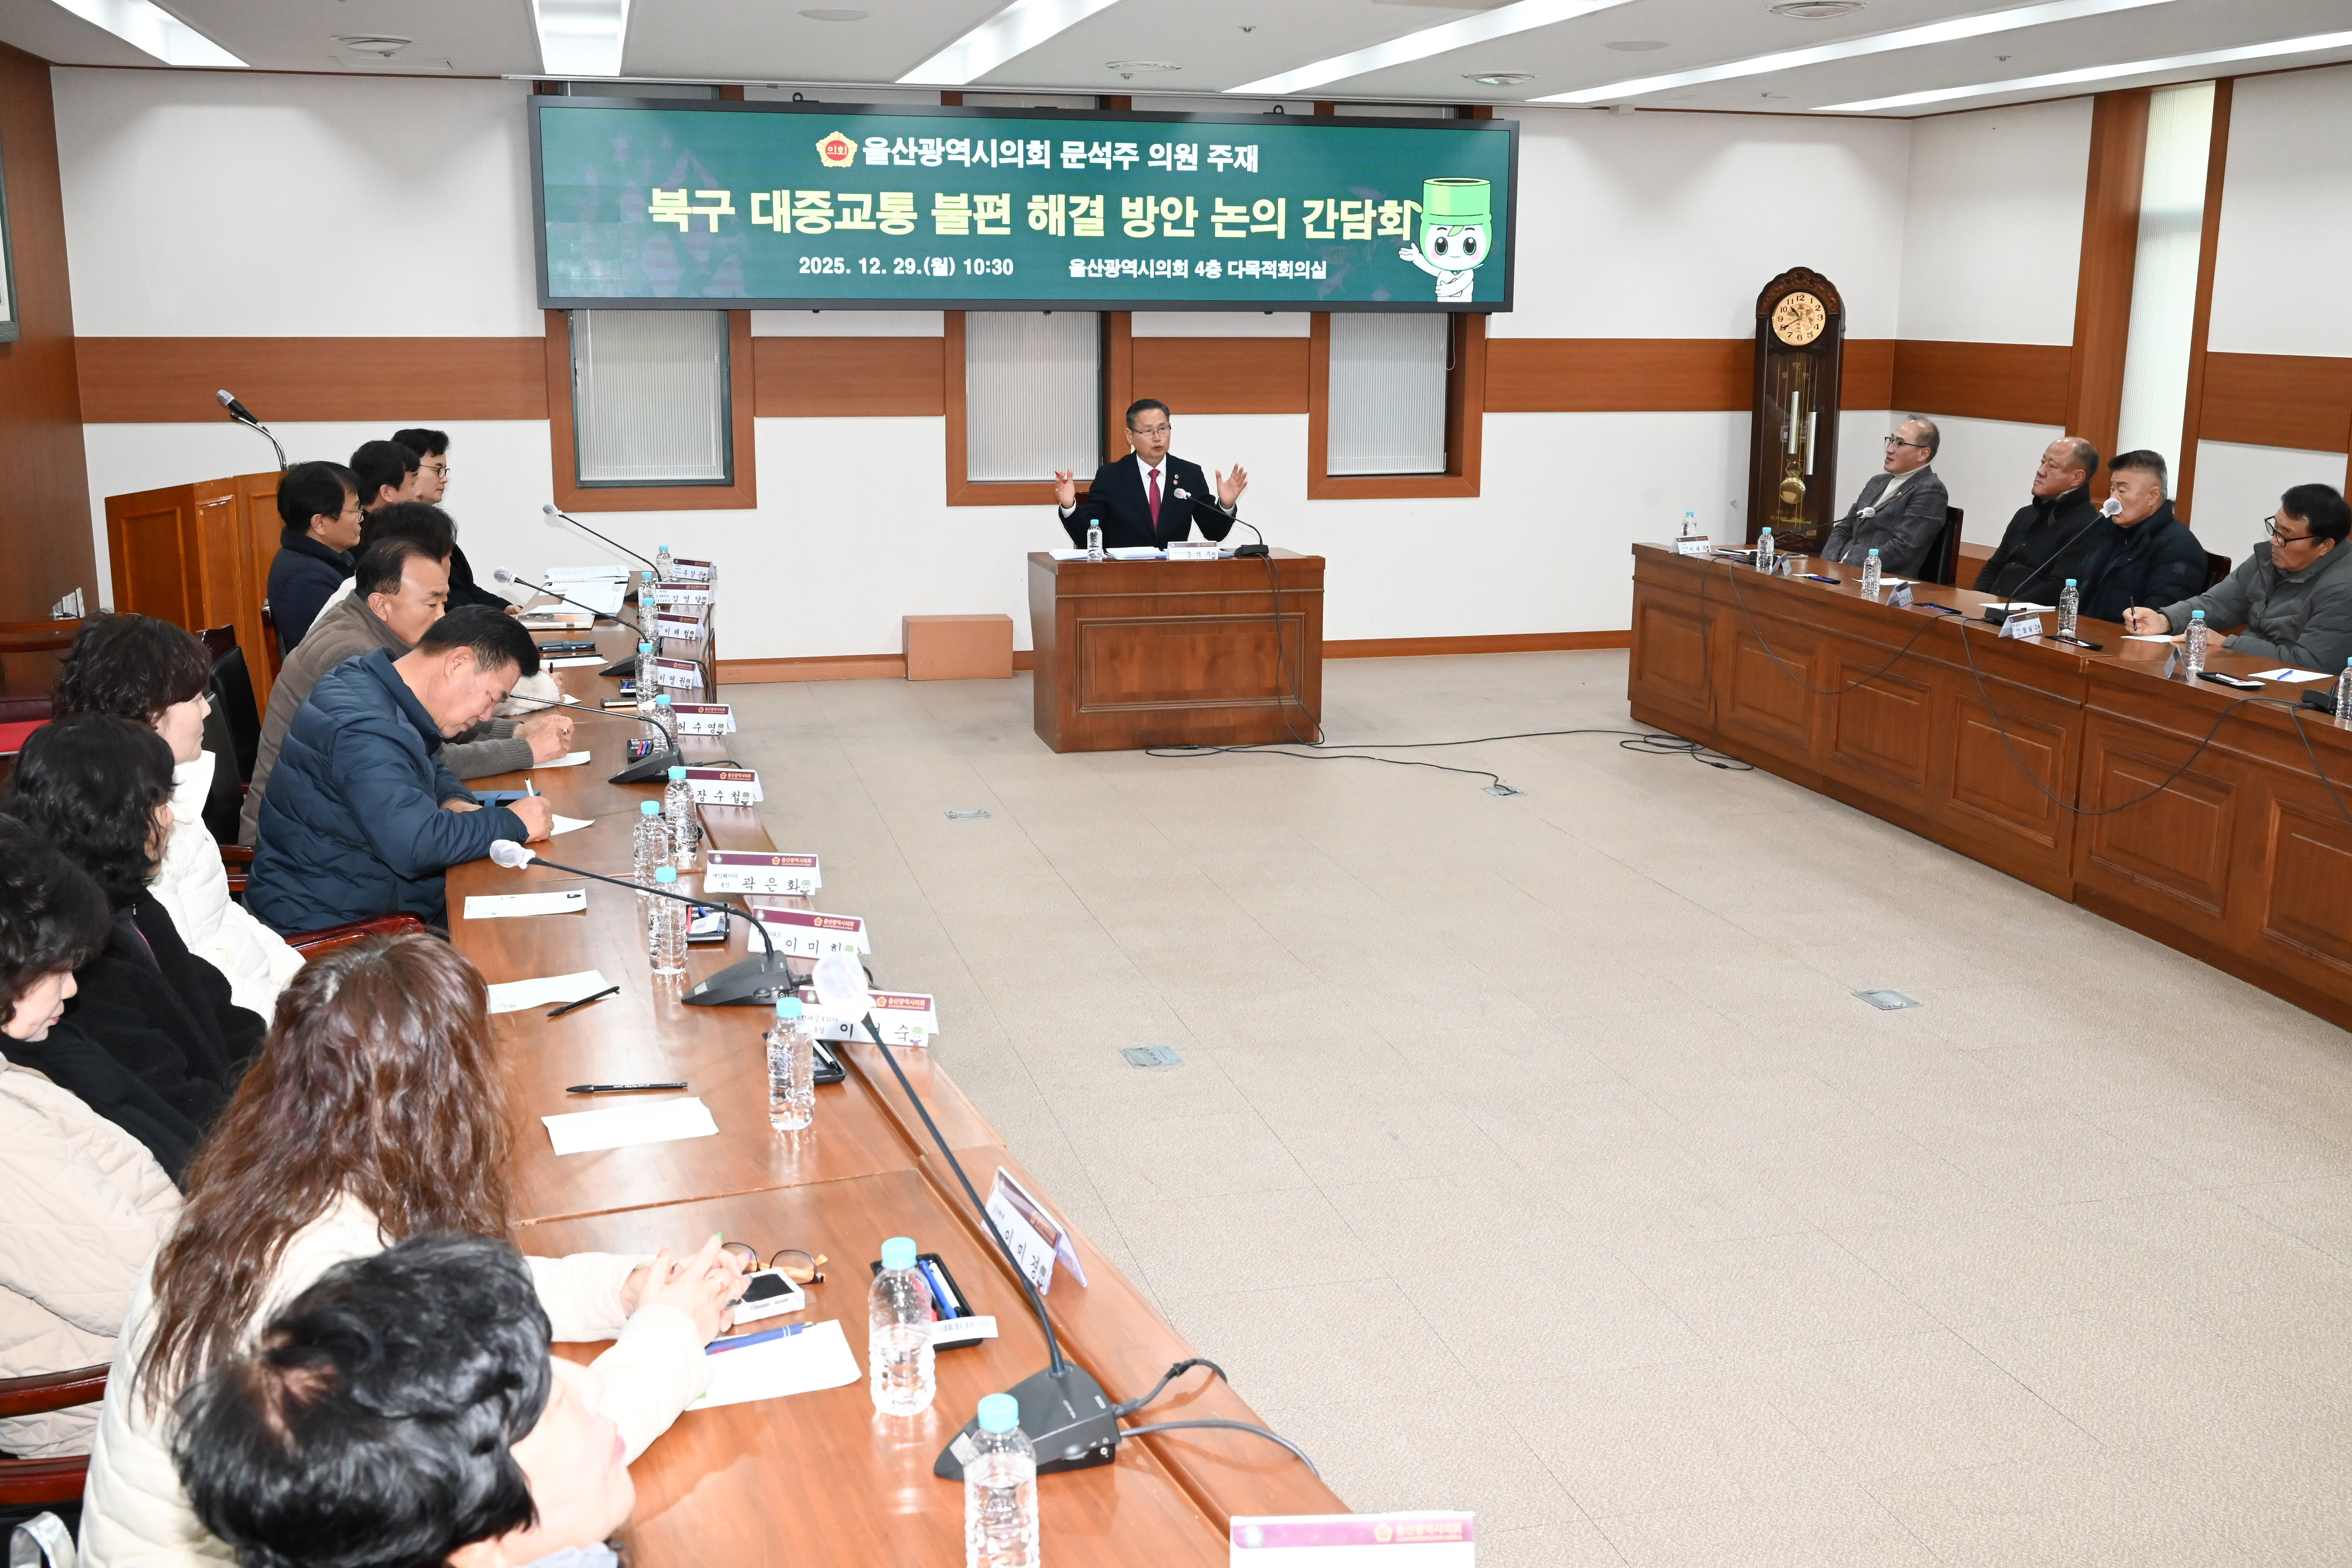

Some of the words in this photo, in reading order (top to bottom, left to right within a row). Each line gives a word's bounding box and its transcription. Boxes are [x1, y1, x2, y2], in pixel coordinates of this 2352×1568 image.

[827, 145, 847, 155] 의회
[863, 137, 1050, 168] 울산광역시의회
[1060, 141, 1139, 170] 문석주
[1148, 143, 1198, 171] 의원
[1207, 145, 1258, 173] 주재
[648, 188, 735, 232] 북구
[751, 190, 917, 235] 대중교통
[932, 193, 1010, 235] 불편
[1027, 194, 1104, 237] 해결
[1122, 196, 1198, 238] 방안
[1211, 198, 1285, 239] 논의
[1302, 199, 1411, 240] 간담회
[799, 257, 850, 274] 2025.
[859, 258, 887, 274] 12.
[893, 257, 956, 277] 29.(월)
[964, 259, 1013, 275] 10:30
[1069, 259, 1189, 278] 울산광역시의회
[1195, 260, 1222, 278] 4층
[1228, 260, 1327, 279] 다목적회의실
[888, 997, 925, 1007] 울산광역시의회
